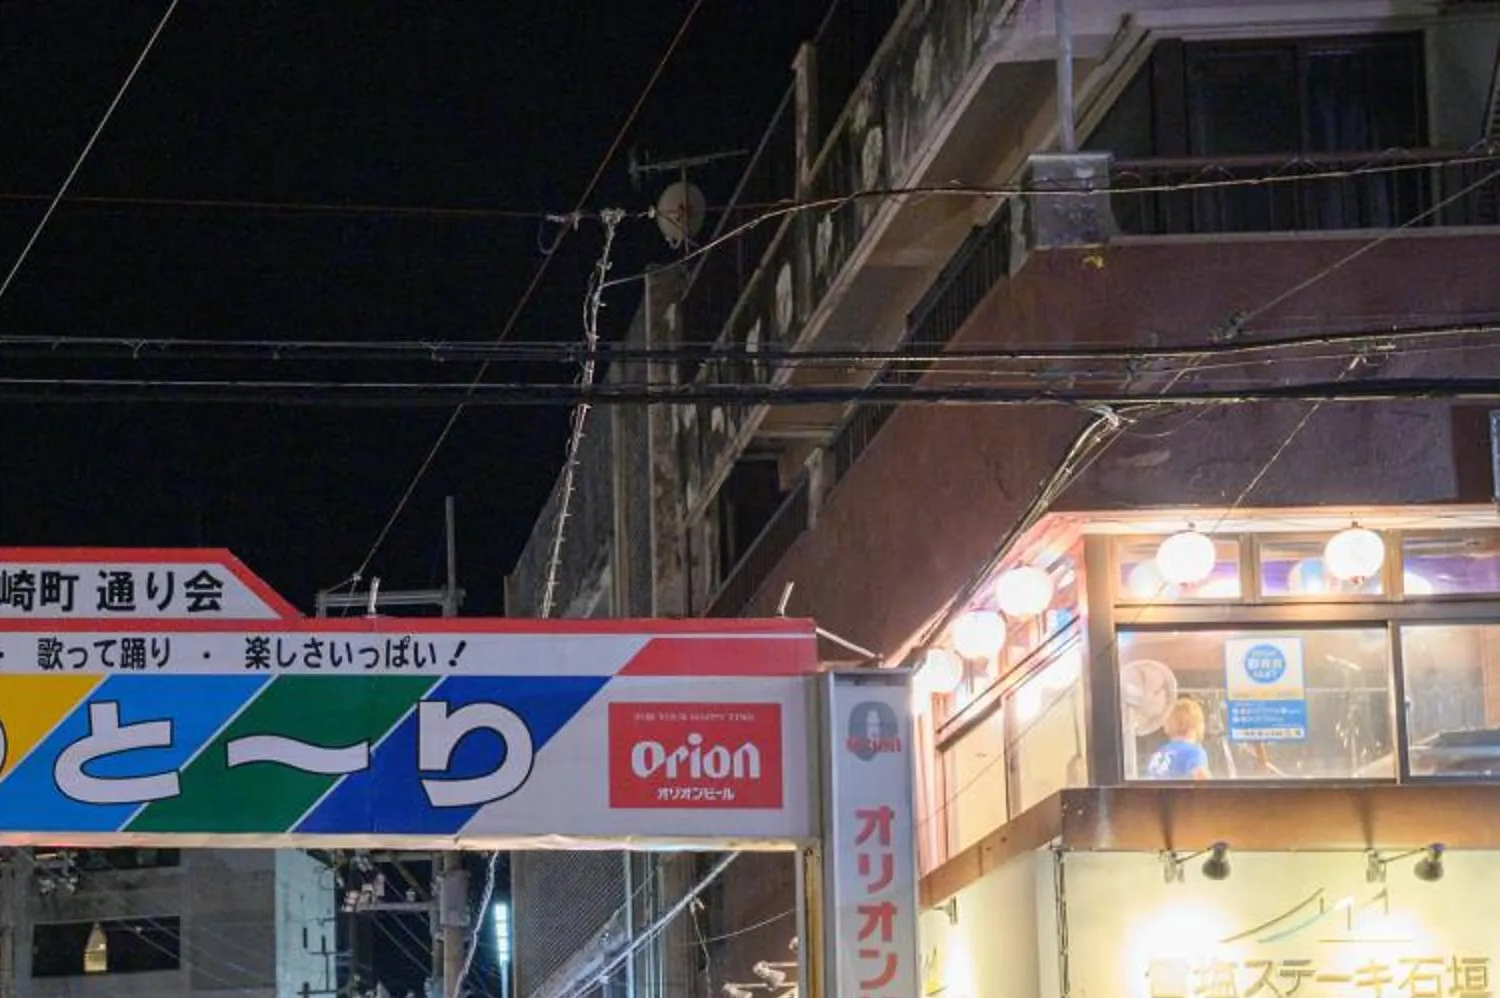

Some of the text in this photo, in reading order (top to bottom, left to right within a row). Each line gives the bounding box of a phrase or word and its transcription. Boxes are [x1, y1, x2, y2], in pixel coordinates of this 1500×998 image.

[37, 636, 171, 670] 歌って踊り
[656, 786, 736, 801] オリオンビール
